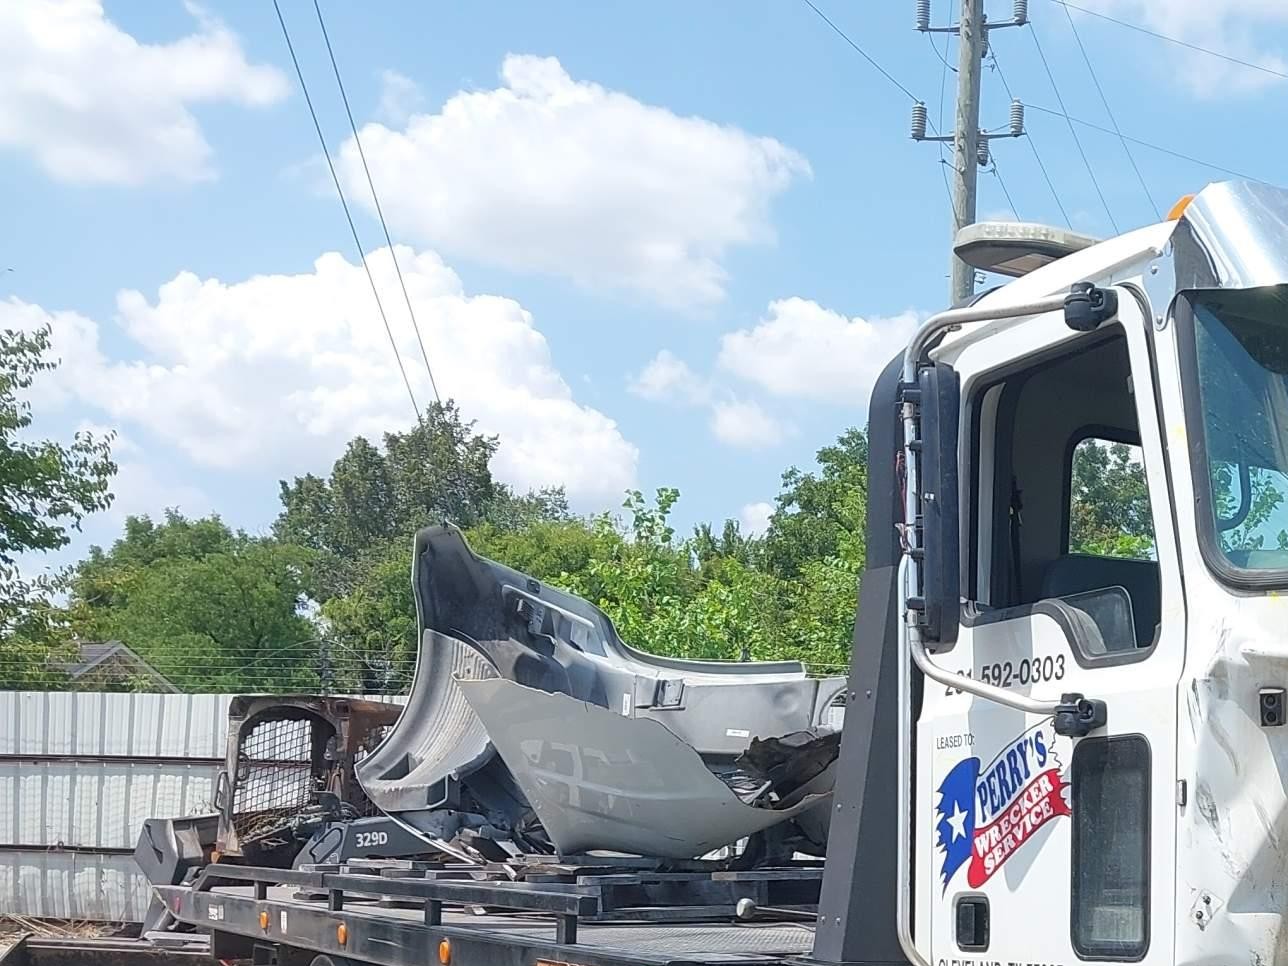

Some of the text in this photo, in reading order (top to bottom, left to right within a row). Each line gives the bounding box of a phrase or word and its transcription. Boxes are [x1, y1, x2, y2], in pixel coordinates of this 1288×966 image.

[936, 732, 975, 750] LEASED TO:
[977, 731, 1047, 823] PERRY'S
[355, 831, 388, 848] 329D
[974, 774, 1054, 858] WRECKER
[983, 796, 1054, 875] SERVICE
